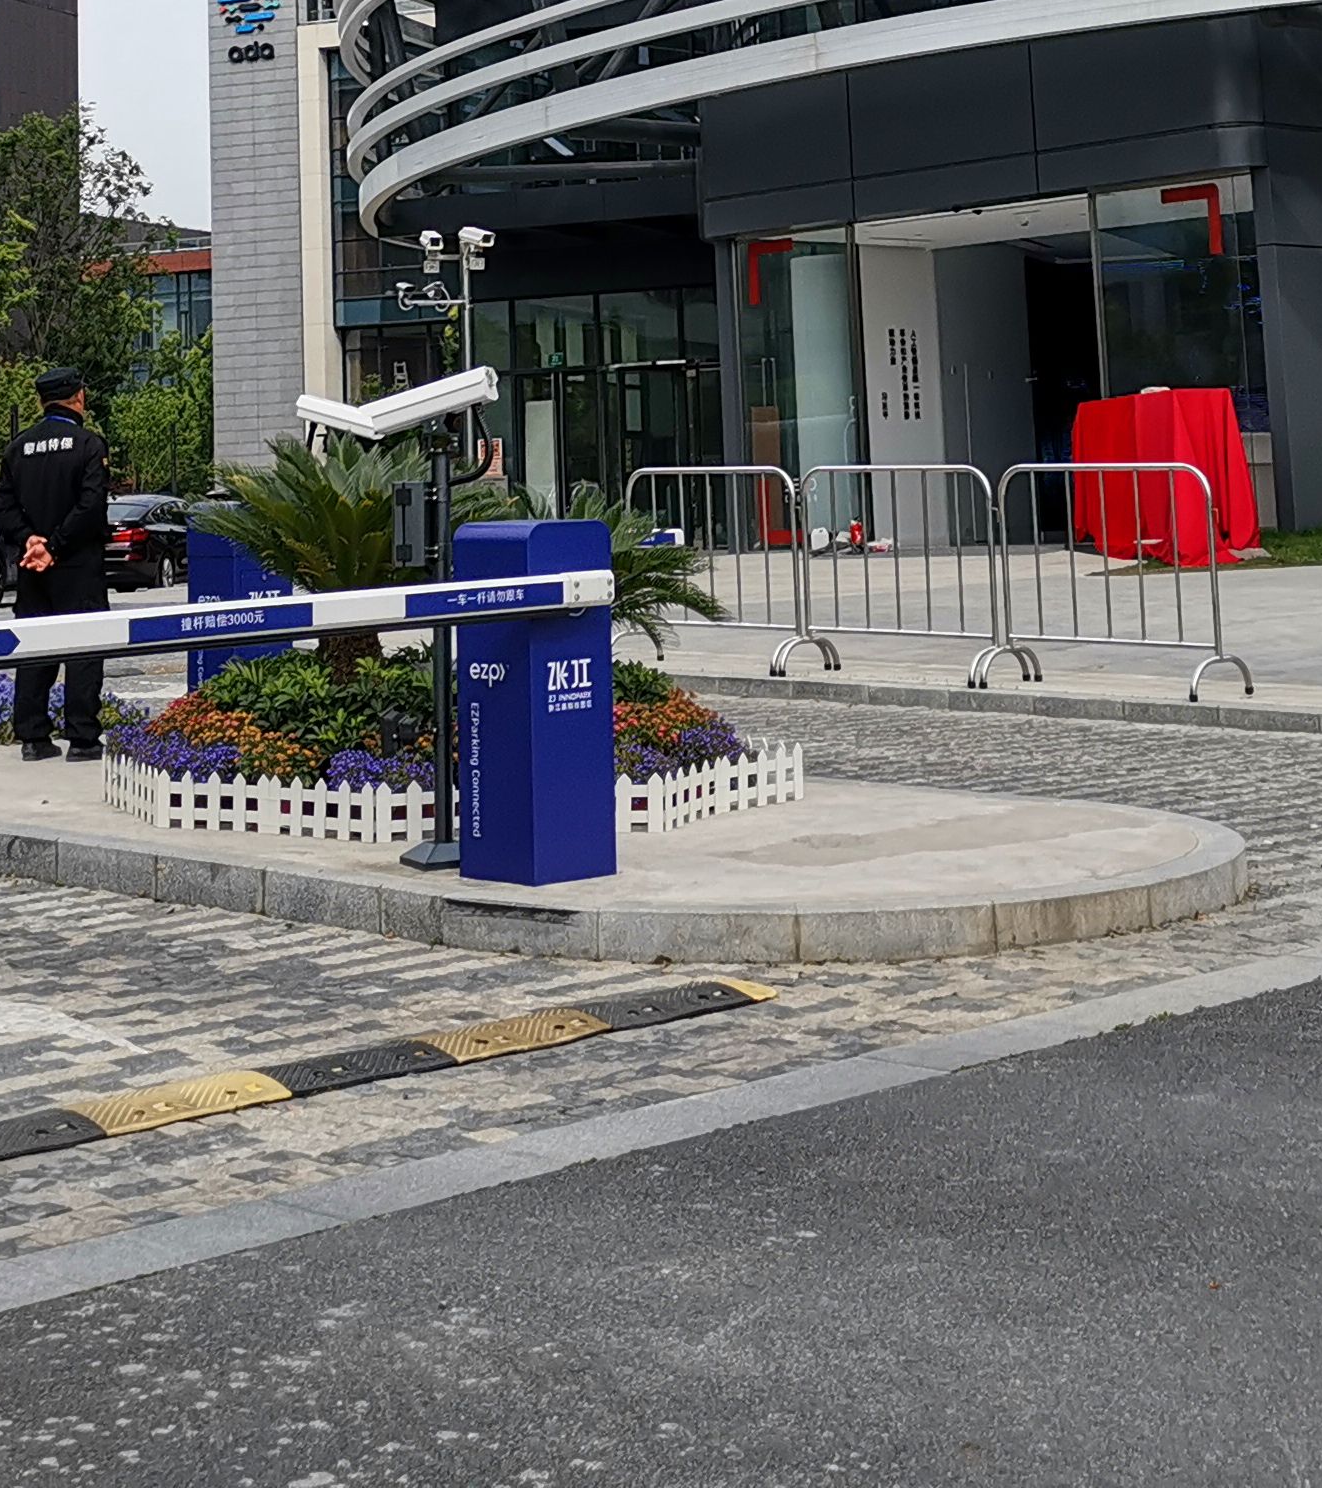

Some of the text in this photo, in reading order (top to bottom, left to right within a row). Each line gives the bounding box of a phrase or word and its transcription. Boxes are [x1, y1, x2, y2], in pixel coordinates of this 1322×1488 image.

[228, 41, 275, 64] ada
[447, 588, 525, 607] 一车一杆请勿跟车
[180, 610, 265, 632] 撞杆赔偿3000元
[470, 702, 482, 838] EZParking Connected
